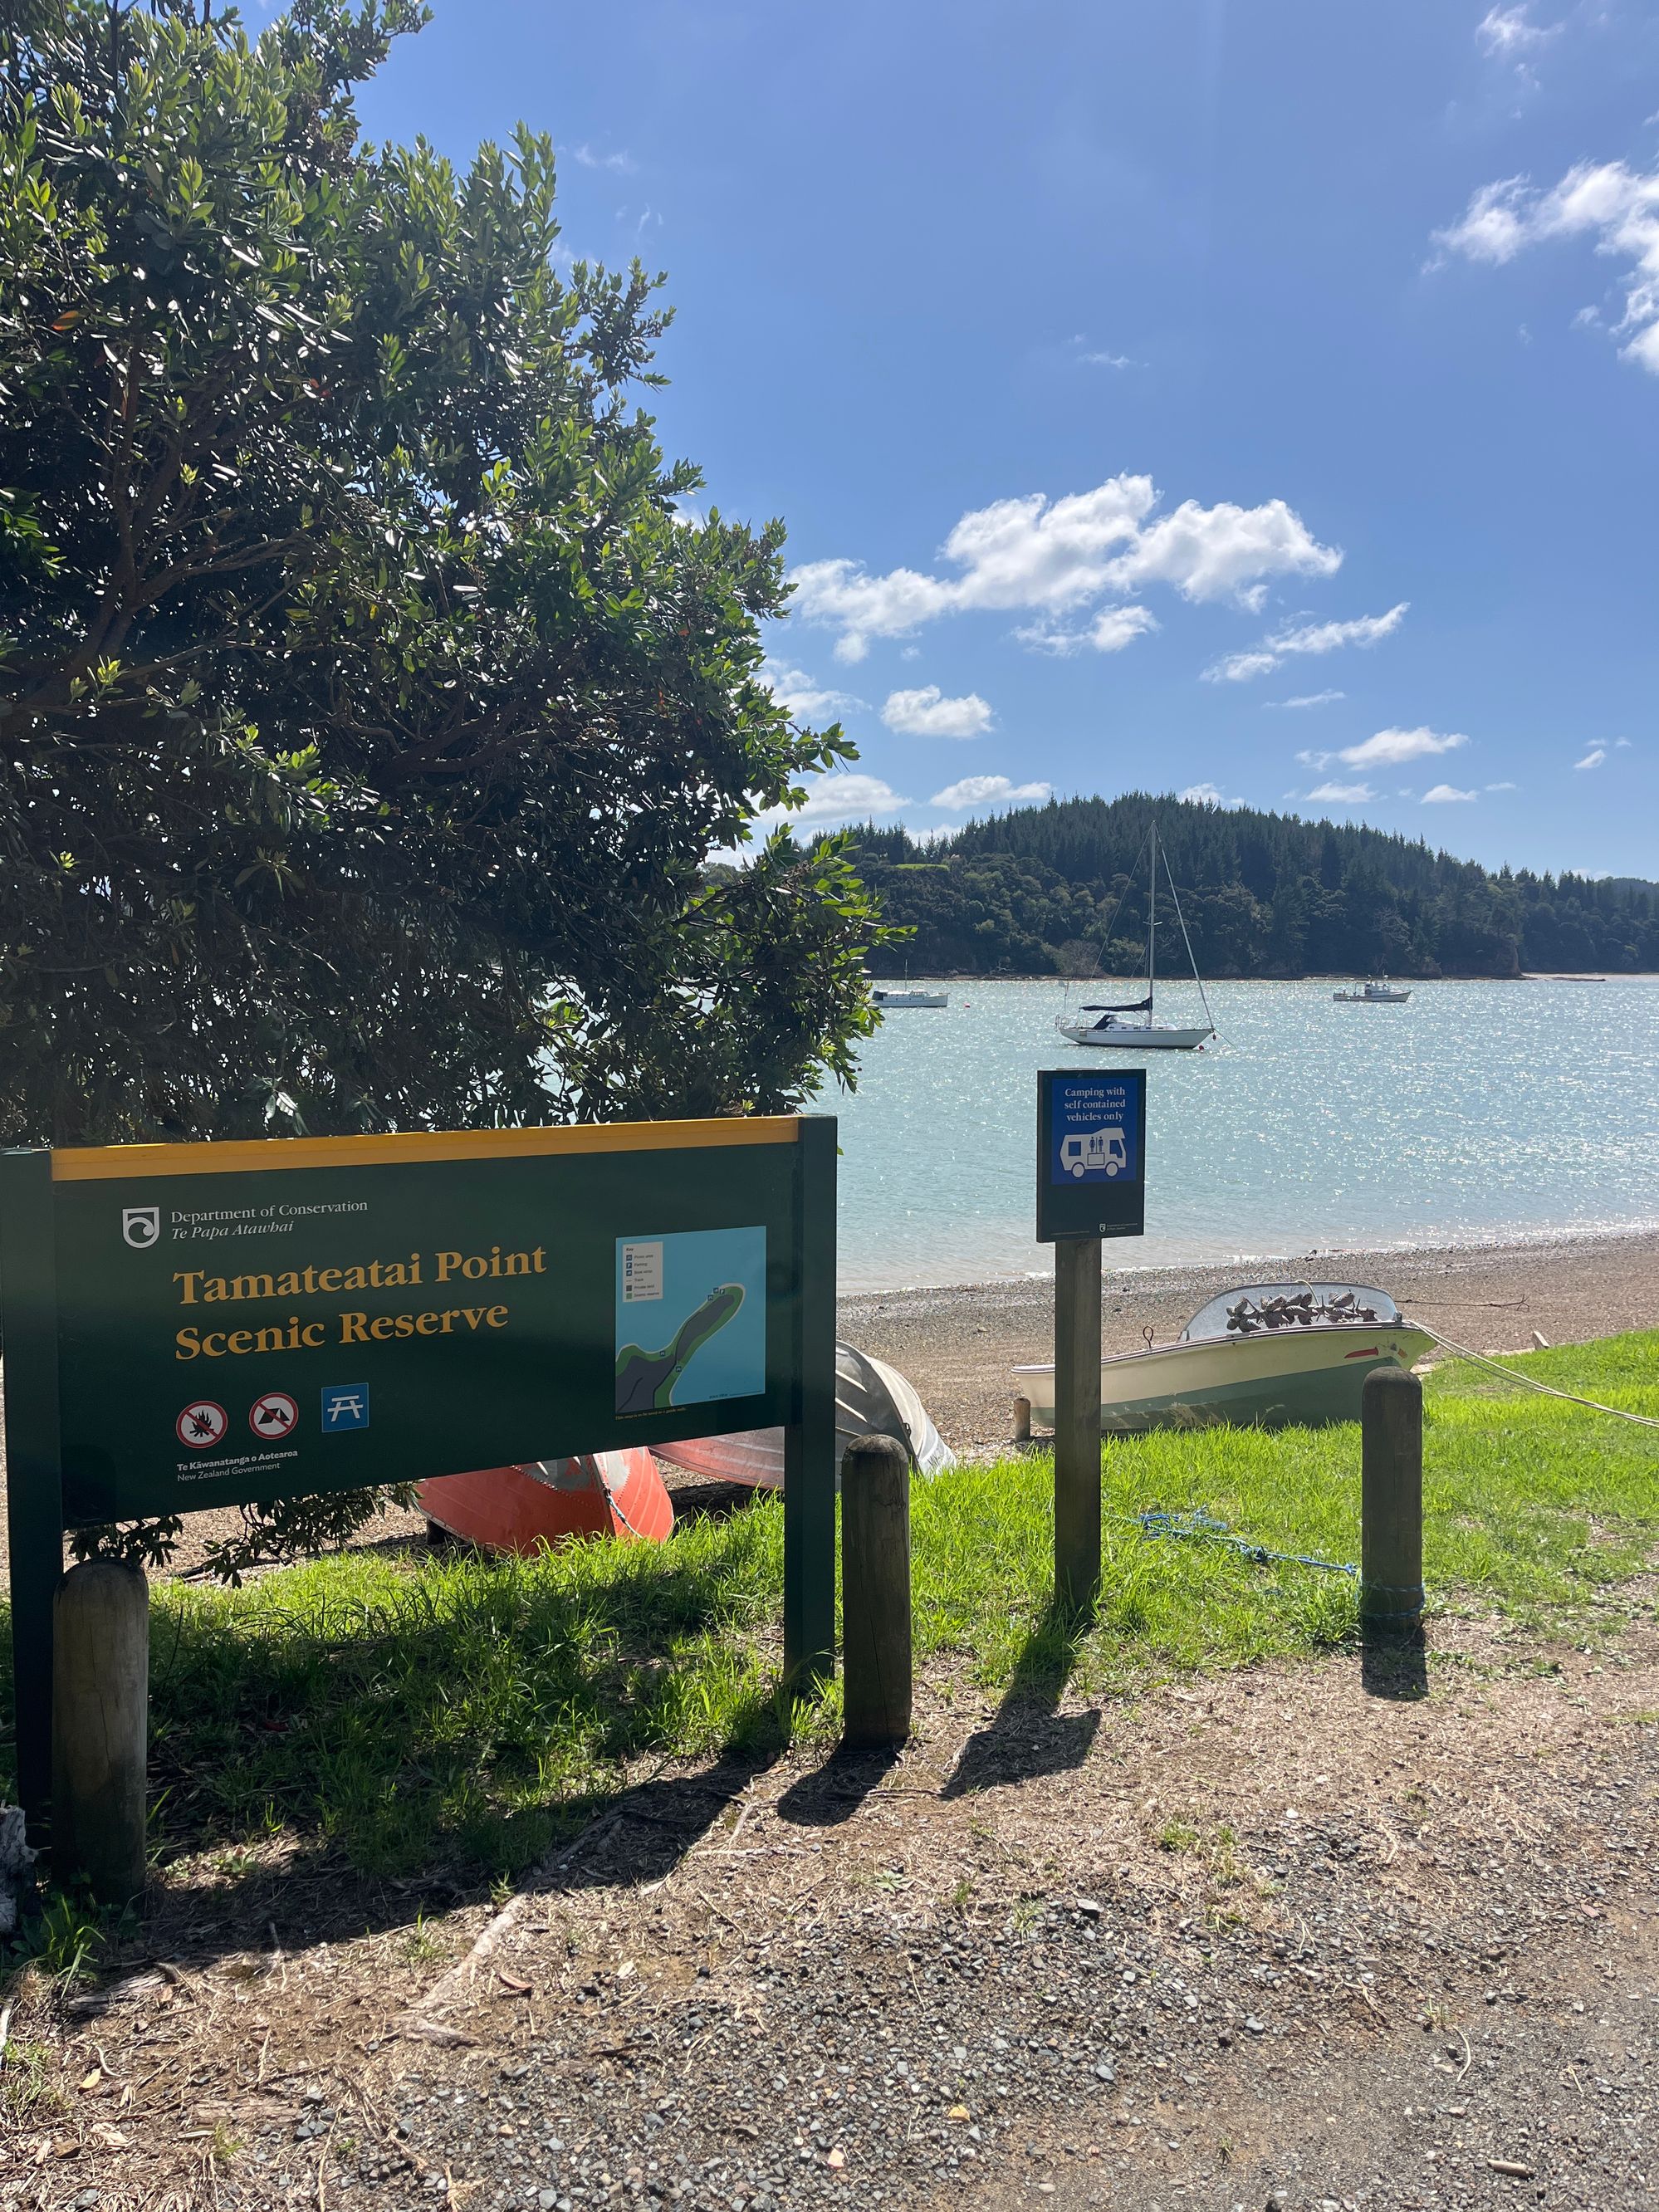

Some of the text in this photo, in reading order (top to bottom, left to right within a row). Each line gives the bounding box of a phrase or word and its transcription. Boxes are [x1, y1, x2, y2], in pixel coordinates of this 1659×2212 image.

[1064, 1086, 1126, 1099] Camping with
[1064, 1099, 1126, 1109] self contained
[1066, 1111, 1123, 1123] vehicles only
[171, 1200, 369, 1226] Department of Conservation
[172, 1221, 294, 1241] Te Papa Atawhai
[173, 1245, 548, 1304] Tamateatai Point
[175, 1304, 509, 1360] Scenic Reserve
[177, 1463, 188, 1471] Te
[189, 1456, 250, 1471] Kāwanatanga
[258, 1451, 298, 1461] Aotearoa
[177, 1462, 281, 1482] New Zealand Government
